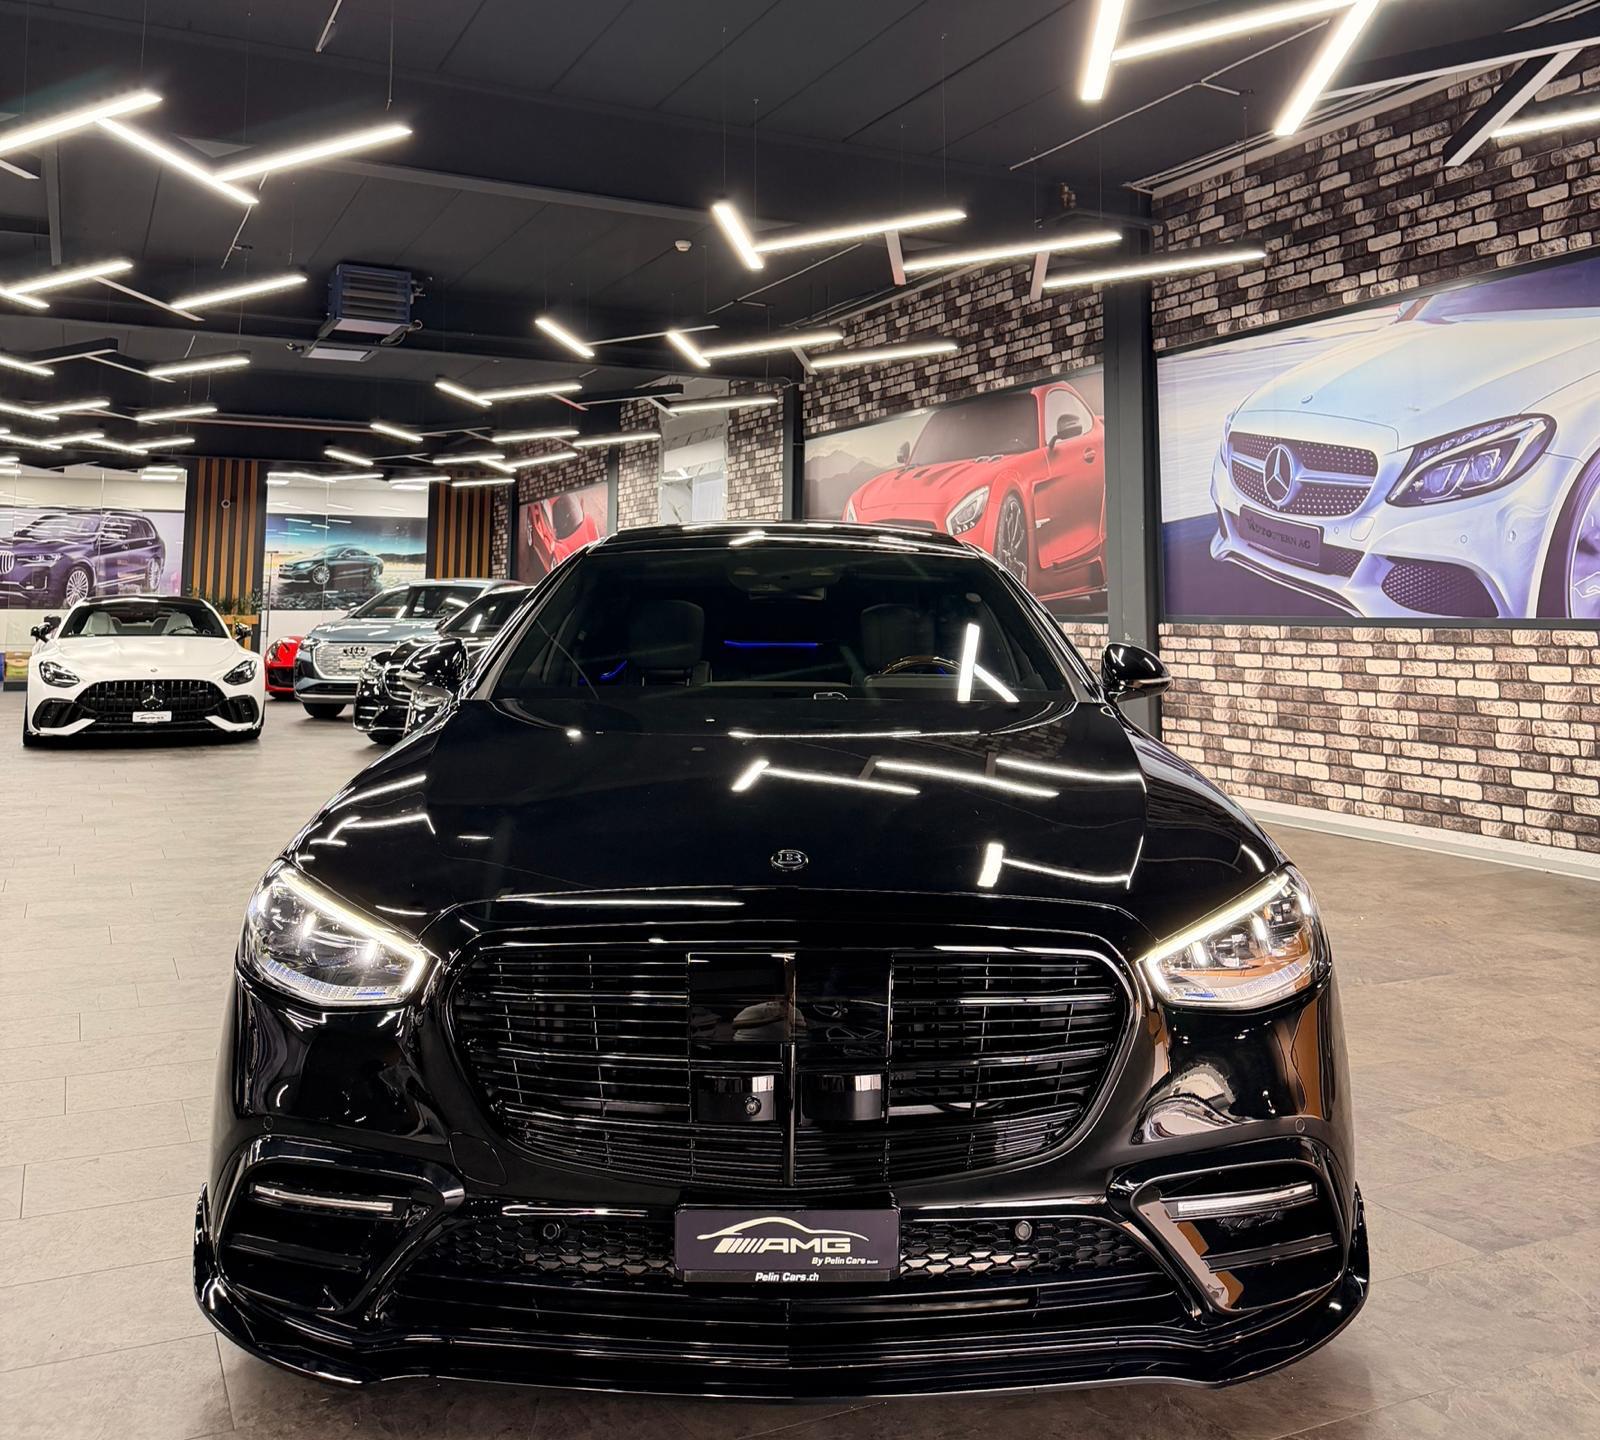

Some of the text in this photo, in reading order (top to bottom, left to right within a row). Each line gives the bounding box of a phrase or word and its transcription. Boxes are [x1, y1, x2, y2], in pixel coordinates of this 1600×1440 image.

[811, 1256, 824, 1267] By
[824, 1256, 845, 1265] Pelin
[846, 1256, 866, 1265] Cars
[755, 1271, 820, 1282] Pelin Cars.ch
